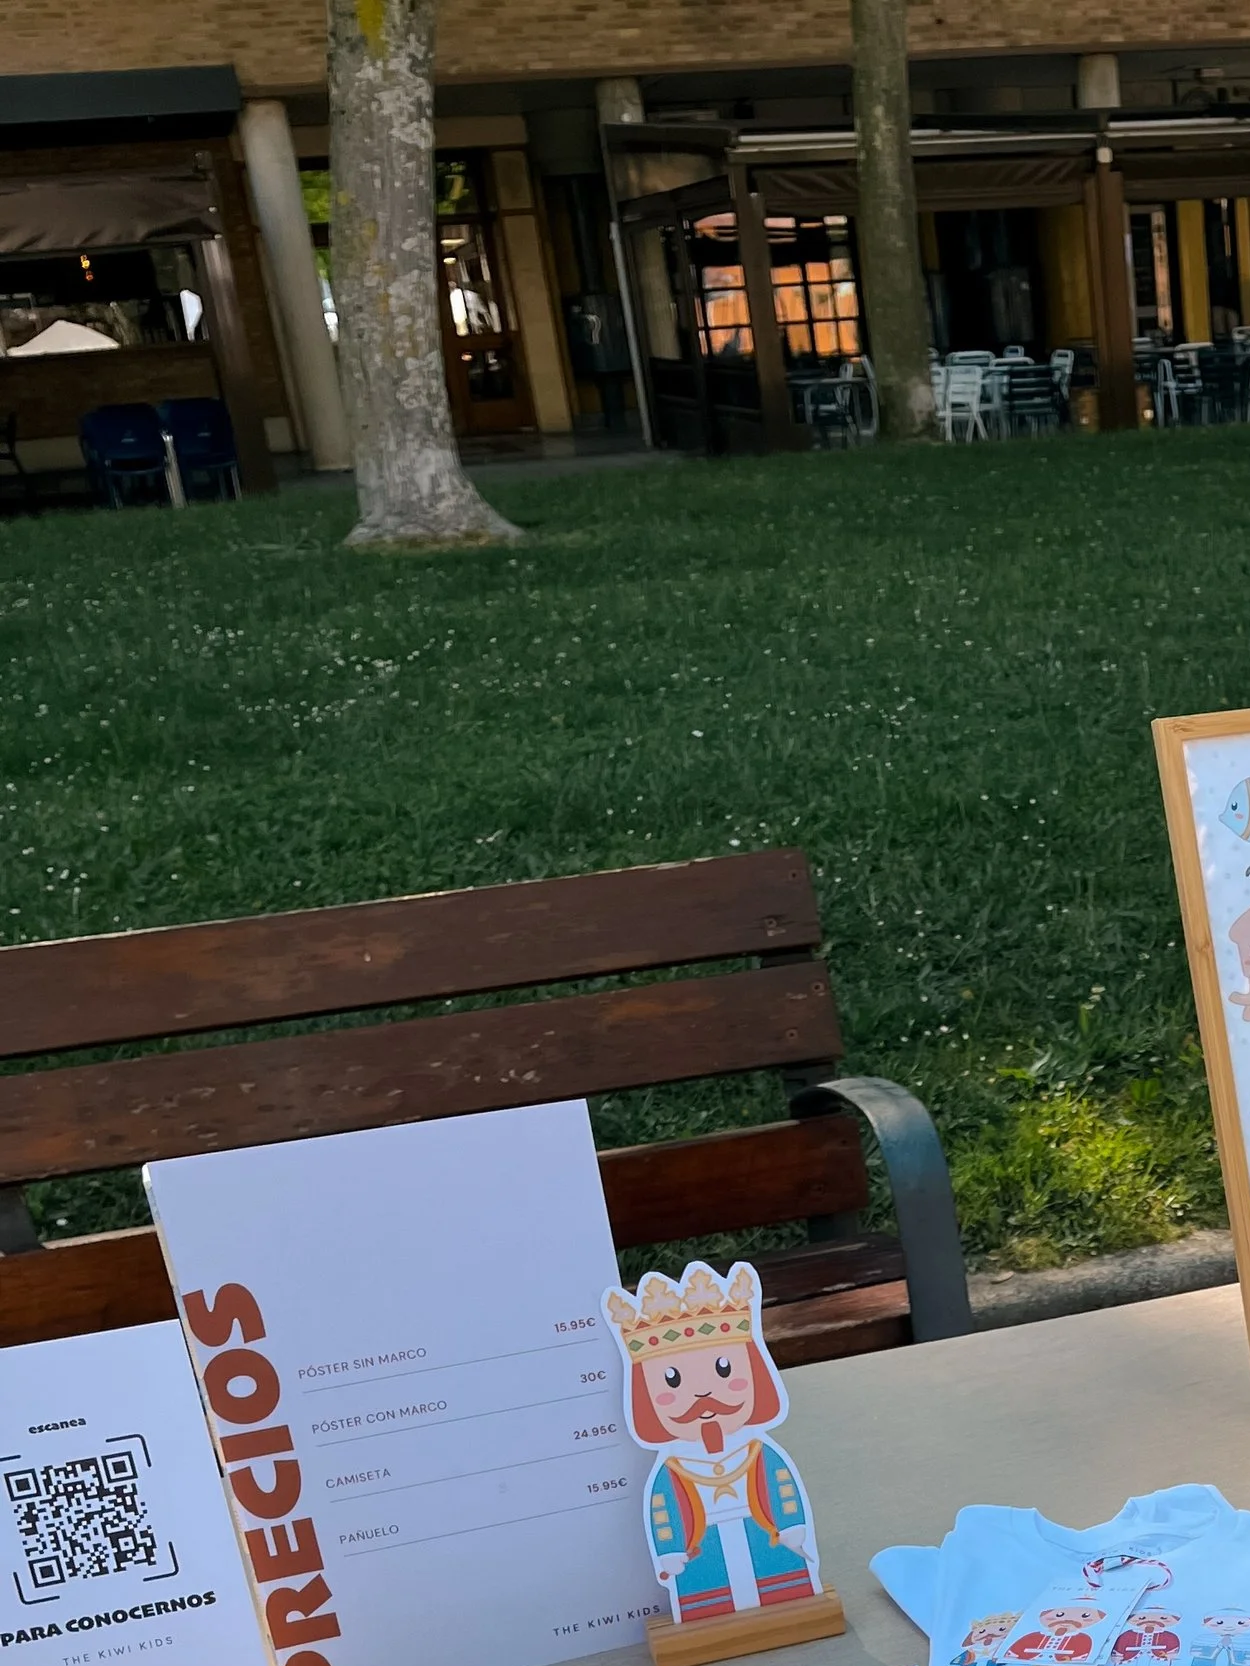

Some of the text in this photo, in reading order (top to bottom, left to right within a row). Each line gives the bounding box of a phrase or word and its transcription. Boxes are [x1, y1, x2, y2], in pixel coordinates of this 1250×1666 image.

[298, 1317, 596, 1380] PÓSTER SIN MARCO 15.95€
[28, 1417, 87, 1435] escanea
[312, 1370, 607, 1434] PÓSTER CON MARCO 30€
[325, 1423, 617, 1489] CAMISETA 24.95€
[339, 1477, 627, 1544] PAÑUELO 15.95€
[0, 1590, 217, 1647] PARA CONOCERNOS
[553, 1604, 661, 1637] THE KIWI KIDS
[62, 1636, 174, 1666] THE KIWI KIDS
